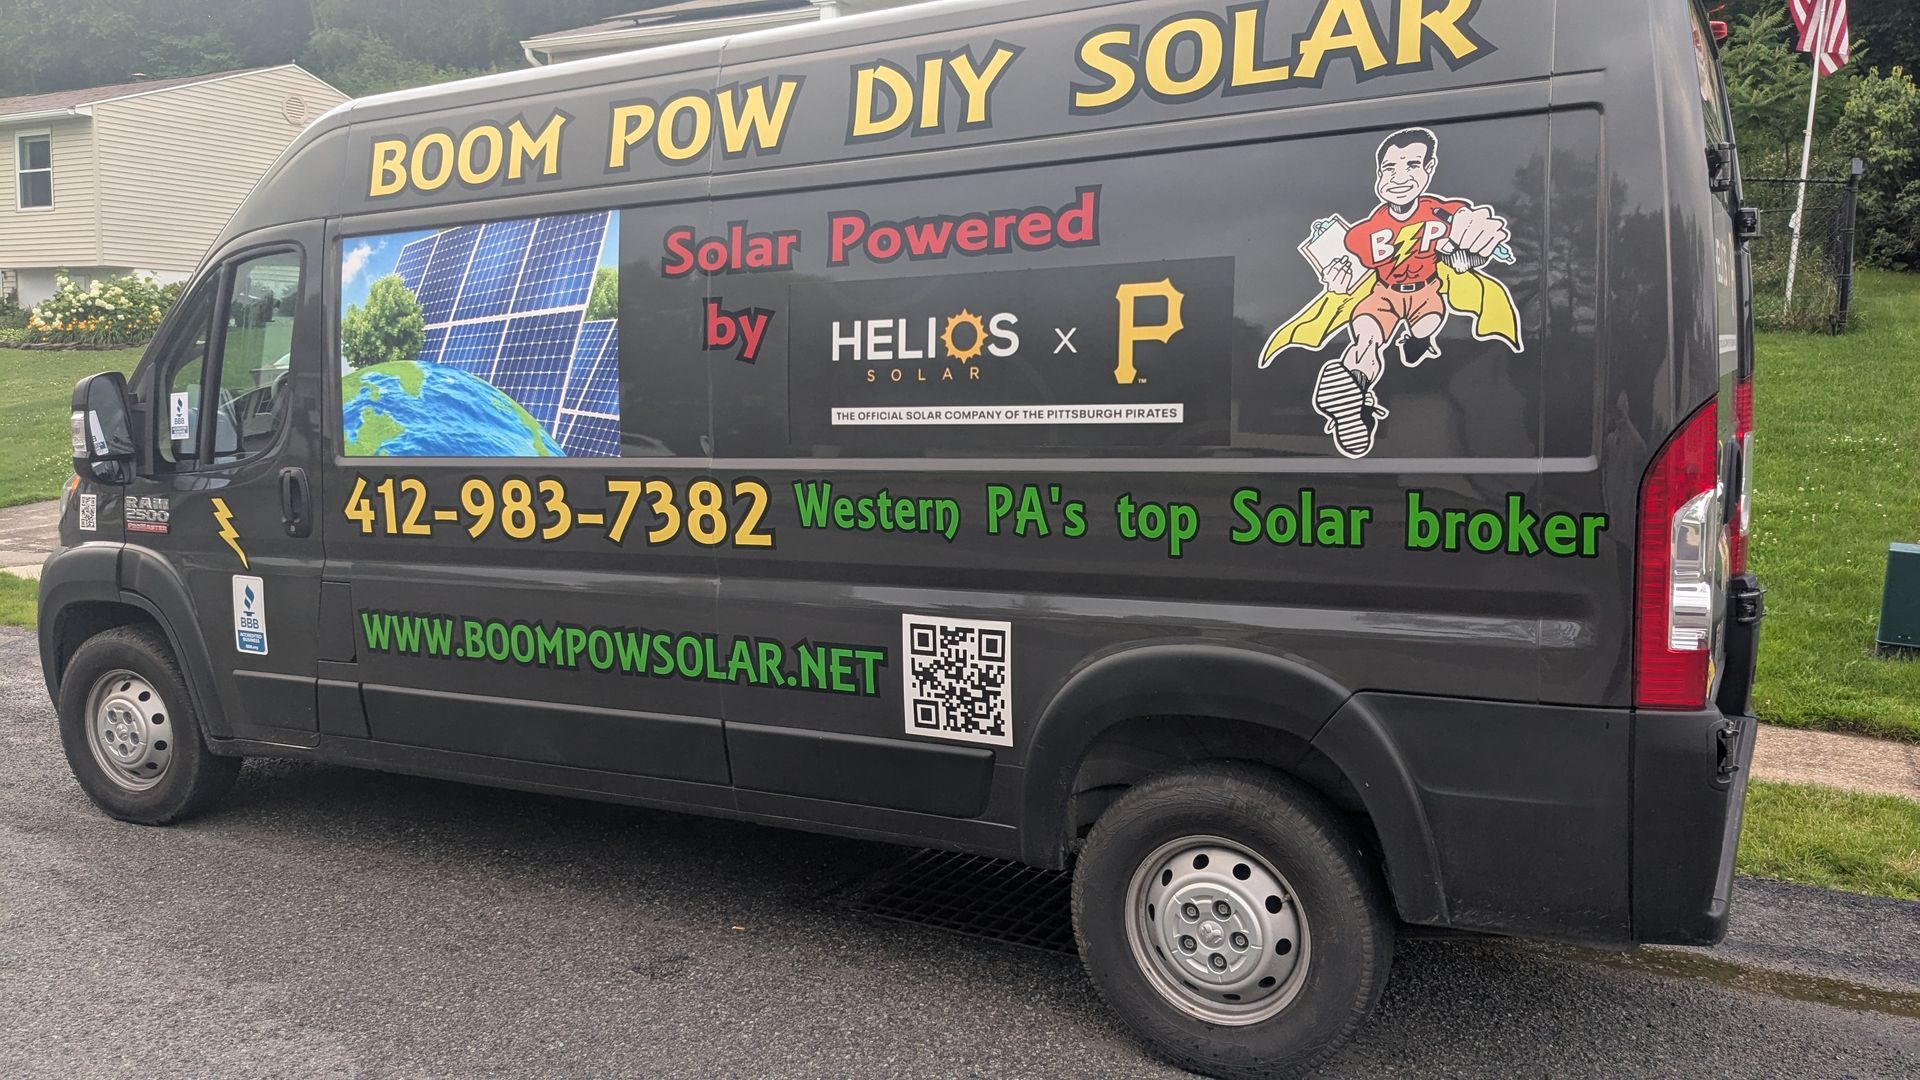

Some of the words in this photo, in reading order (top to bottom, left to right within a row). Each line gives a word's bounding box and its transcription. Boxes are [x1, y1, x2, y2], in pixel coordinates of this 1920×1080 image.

[370, 114, 566, 198] BOOM
[608, 81, 798, 169] POW
[852, 48, 1014, 136] DIY
[1074, 0, 1479, 109] SOLAR
[664, 226, 797, 276] Solar
[830, 190, 1096, 263] Powered
[706, 302, 769, 360] by
[832, 309, 1020, 363] HELIOS
[1113, 278, 1185, 385] P
[866, 366, 981, 382] SOLAR
[836, 411, 856, 421] THE
[857, 411, 904, 421] OFFICIAL
[905, 410, 942, 420] SOLAR
[944, 410, 1002, 420] COMPANY
[1004, 410, 1020, 419] OF
[1022, 409, 1044, 419] THE
[1047, 409, 1123, 419] PITTSBURGH
[1125, 408, 1178, 418] PIRATES
[125, 496, 170, 509] RAM
[126, 508, 170, 522] 2500
[343, 477, 773, 547] 412-983-7382
[792, 482, 961, 540] Western
[985, 484, 1088, 538] PA's
[1116, 494, 1199, 557] top
[1231, 488, 1372, 547] Solar
[1406, 491, 1608, 556] broker
[240, 617, 259, 628] BBB
[360, 613, 884, 695] WWW.BOOMPOWSOLAR.NET
